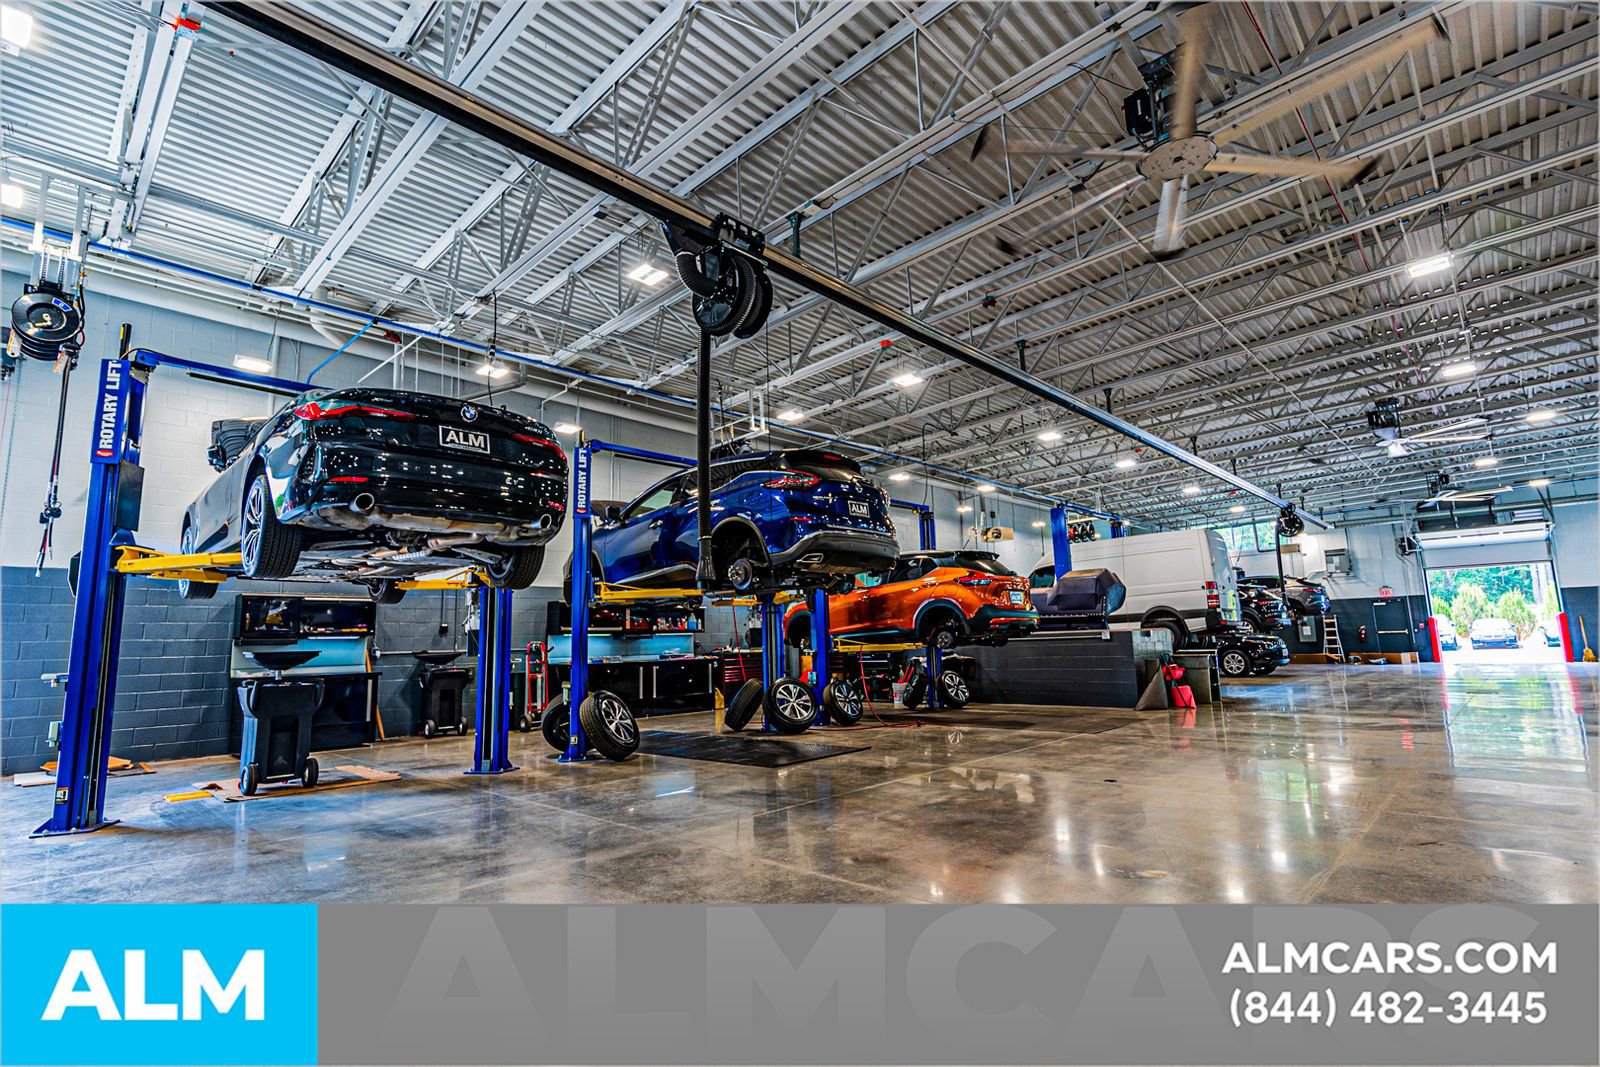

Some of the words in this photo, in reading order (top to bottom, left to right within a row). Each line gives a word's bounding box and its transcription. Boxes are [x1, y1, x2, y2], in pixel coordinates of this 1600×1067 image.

[105, 361, 122, 390] LIFT
[98, 393, 119, 450] ROTARY
[445, 430, 486, 448] ALM
[578, 448, 588, 469] LIFT
[577, 470, 587, 509] ROTARY
[851, 503, 868, 515] ALM
